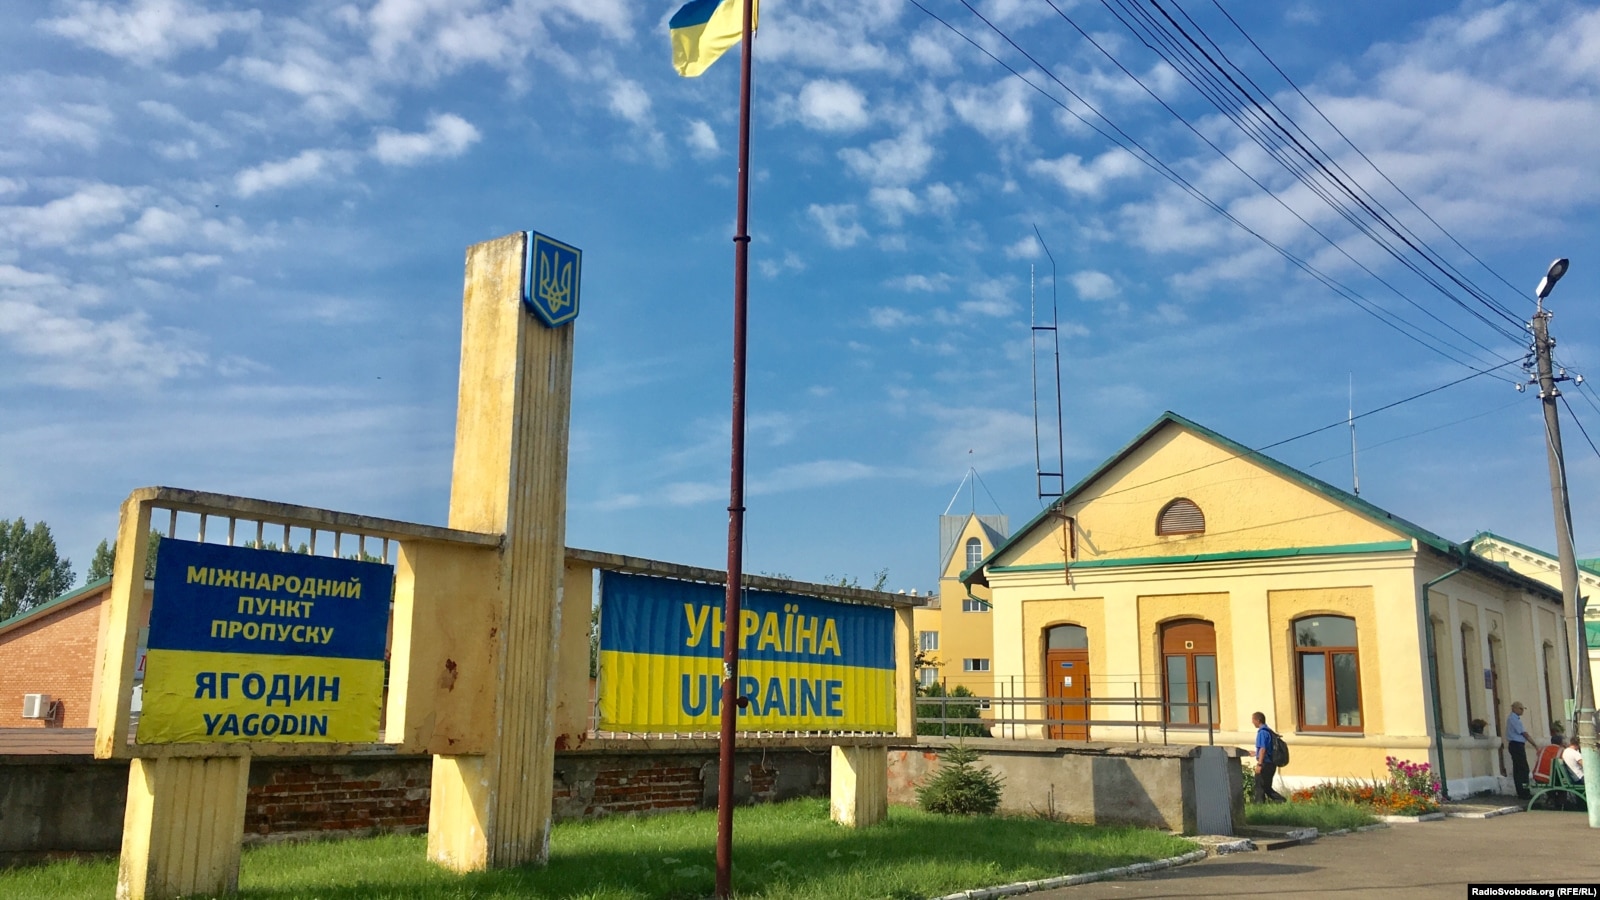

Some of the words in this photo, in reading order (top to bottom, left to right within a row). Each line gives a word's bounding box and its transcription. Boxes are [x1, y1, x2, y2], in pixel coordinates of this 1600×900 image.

[186, 566, 362, 599] МІЖНАРОДНИЙ
[237, 596, 314, 619] ПУНКТ
[210, 620, 334, 644] ПРОПУСКУ
[194, 671, 341, 707] ЯГОДИН
[203, 713, 328, 737] YAGODIN
